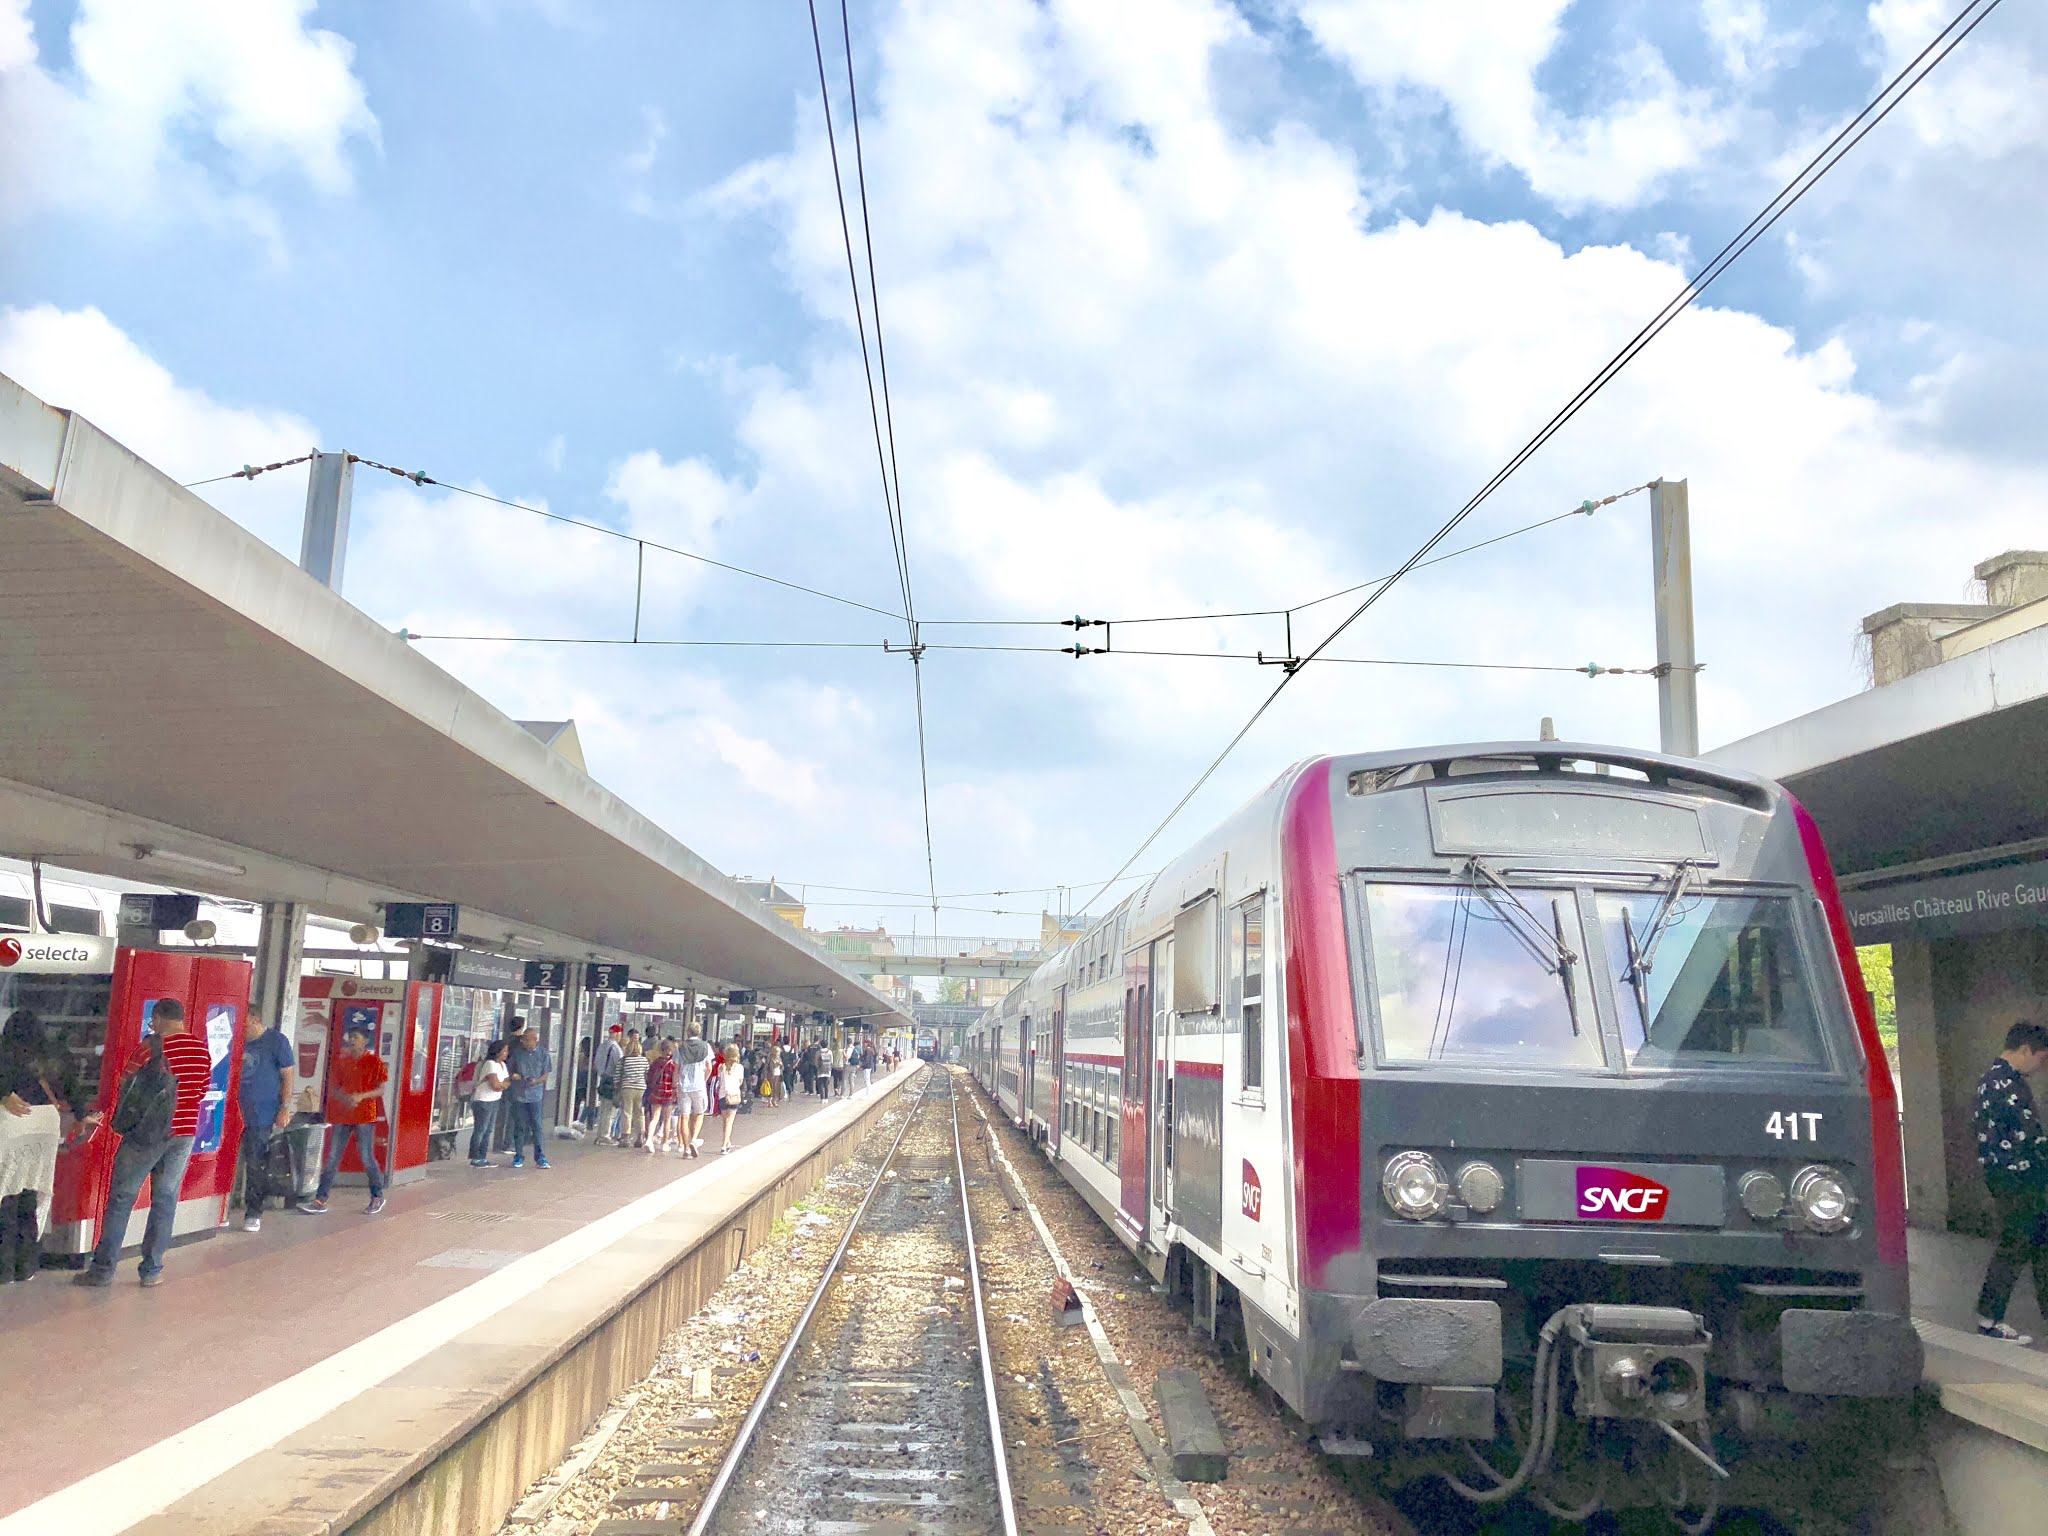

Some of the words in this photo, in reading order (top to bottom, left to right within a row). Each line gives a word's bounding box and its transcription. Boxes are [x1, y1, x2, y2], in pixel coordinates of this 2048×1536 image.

[131, 908, 142, 922] 8
[1848, 903, 1911, 928] Versailles
[1914, 897, 1973, 919] Château
[1976, 889, 2010, 910] Rive
[431, 917, 442, 932] 8
[26, 946, 89, 961] selecta
[540, 970, 551, 986] 2
[598, 973, 609, 988] 3
[359, 985, 394, 994] selecta
[1765, 1111, 1823, 1141] 41T
[1243, 1181, 1261, 1213] SNCF
[1580, 1187, 1664, 1213] SNCF
